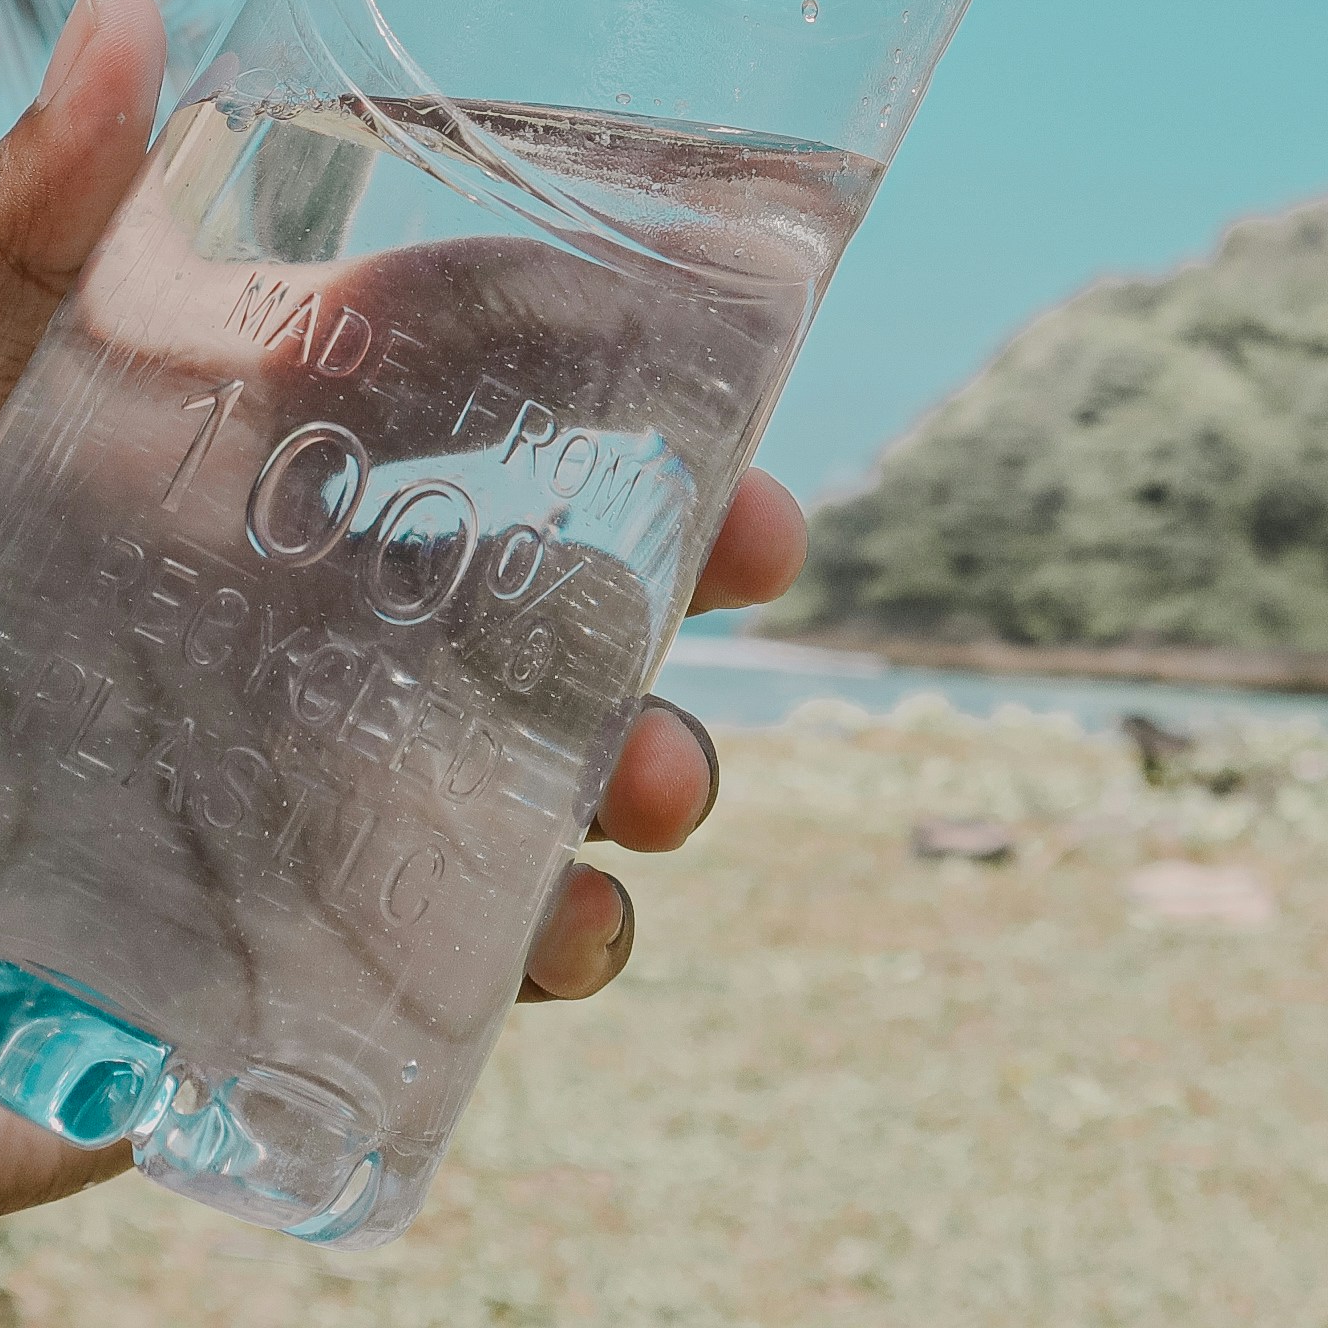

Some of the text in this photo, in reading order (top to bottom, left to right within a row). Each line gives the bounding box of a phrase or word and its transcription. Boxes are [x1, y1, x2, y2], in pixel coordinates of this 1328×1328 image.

[223, 268, 646, 527] MADE FROM
[80, 534, 505, 805] RECYCLED
[160, 379, 587, 693] 100%
[7, 653, 450, 927] PLASTIC
